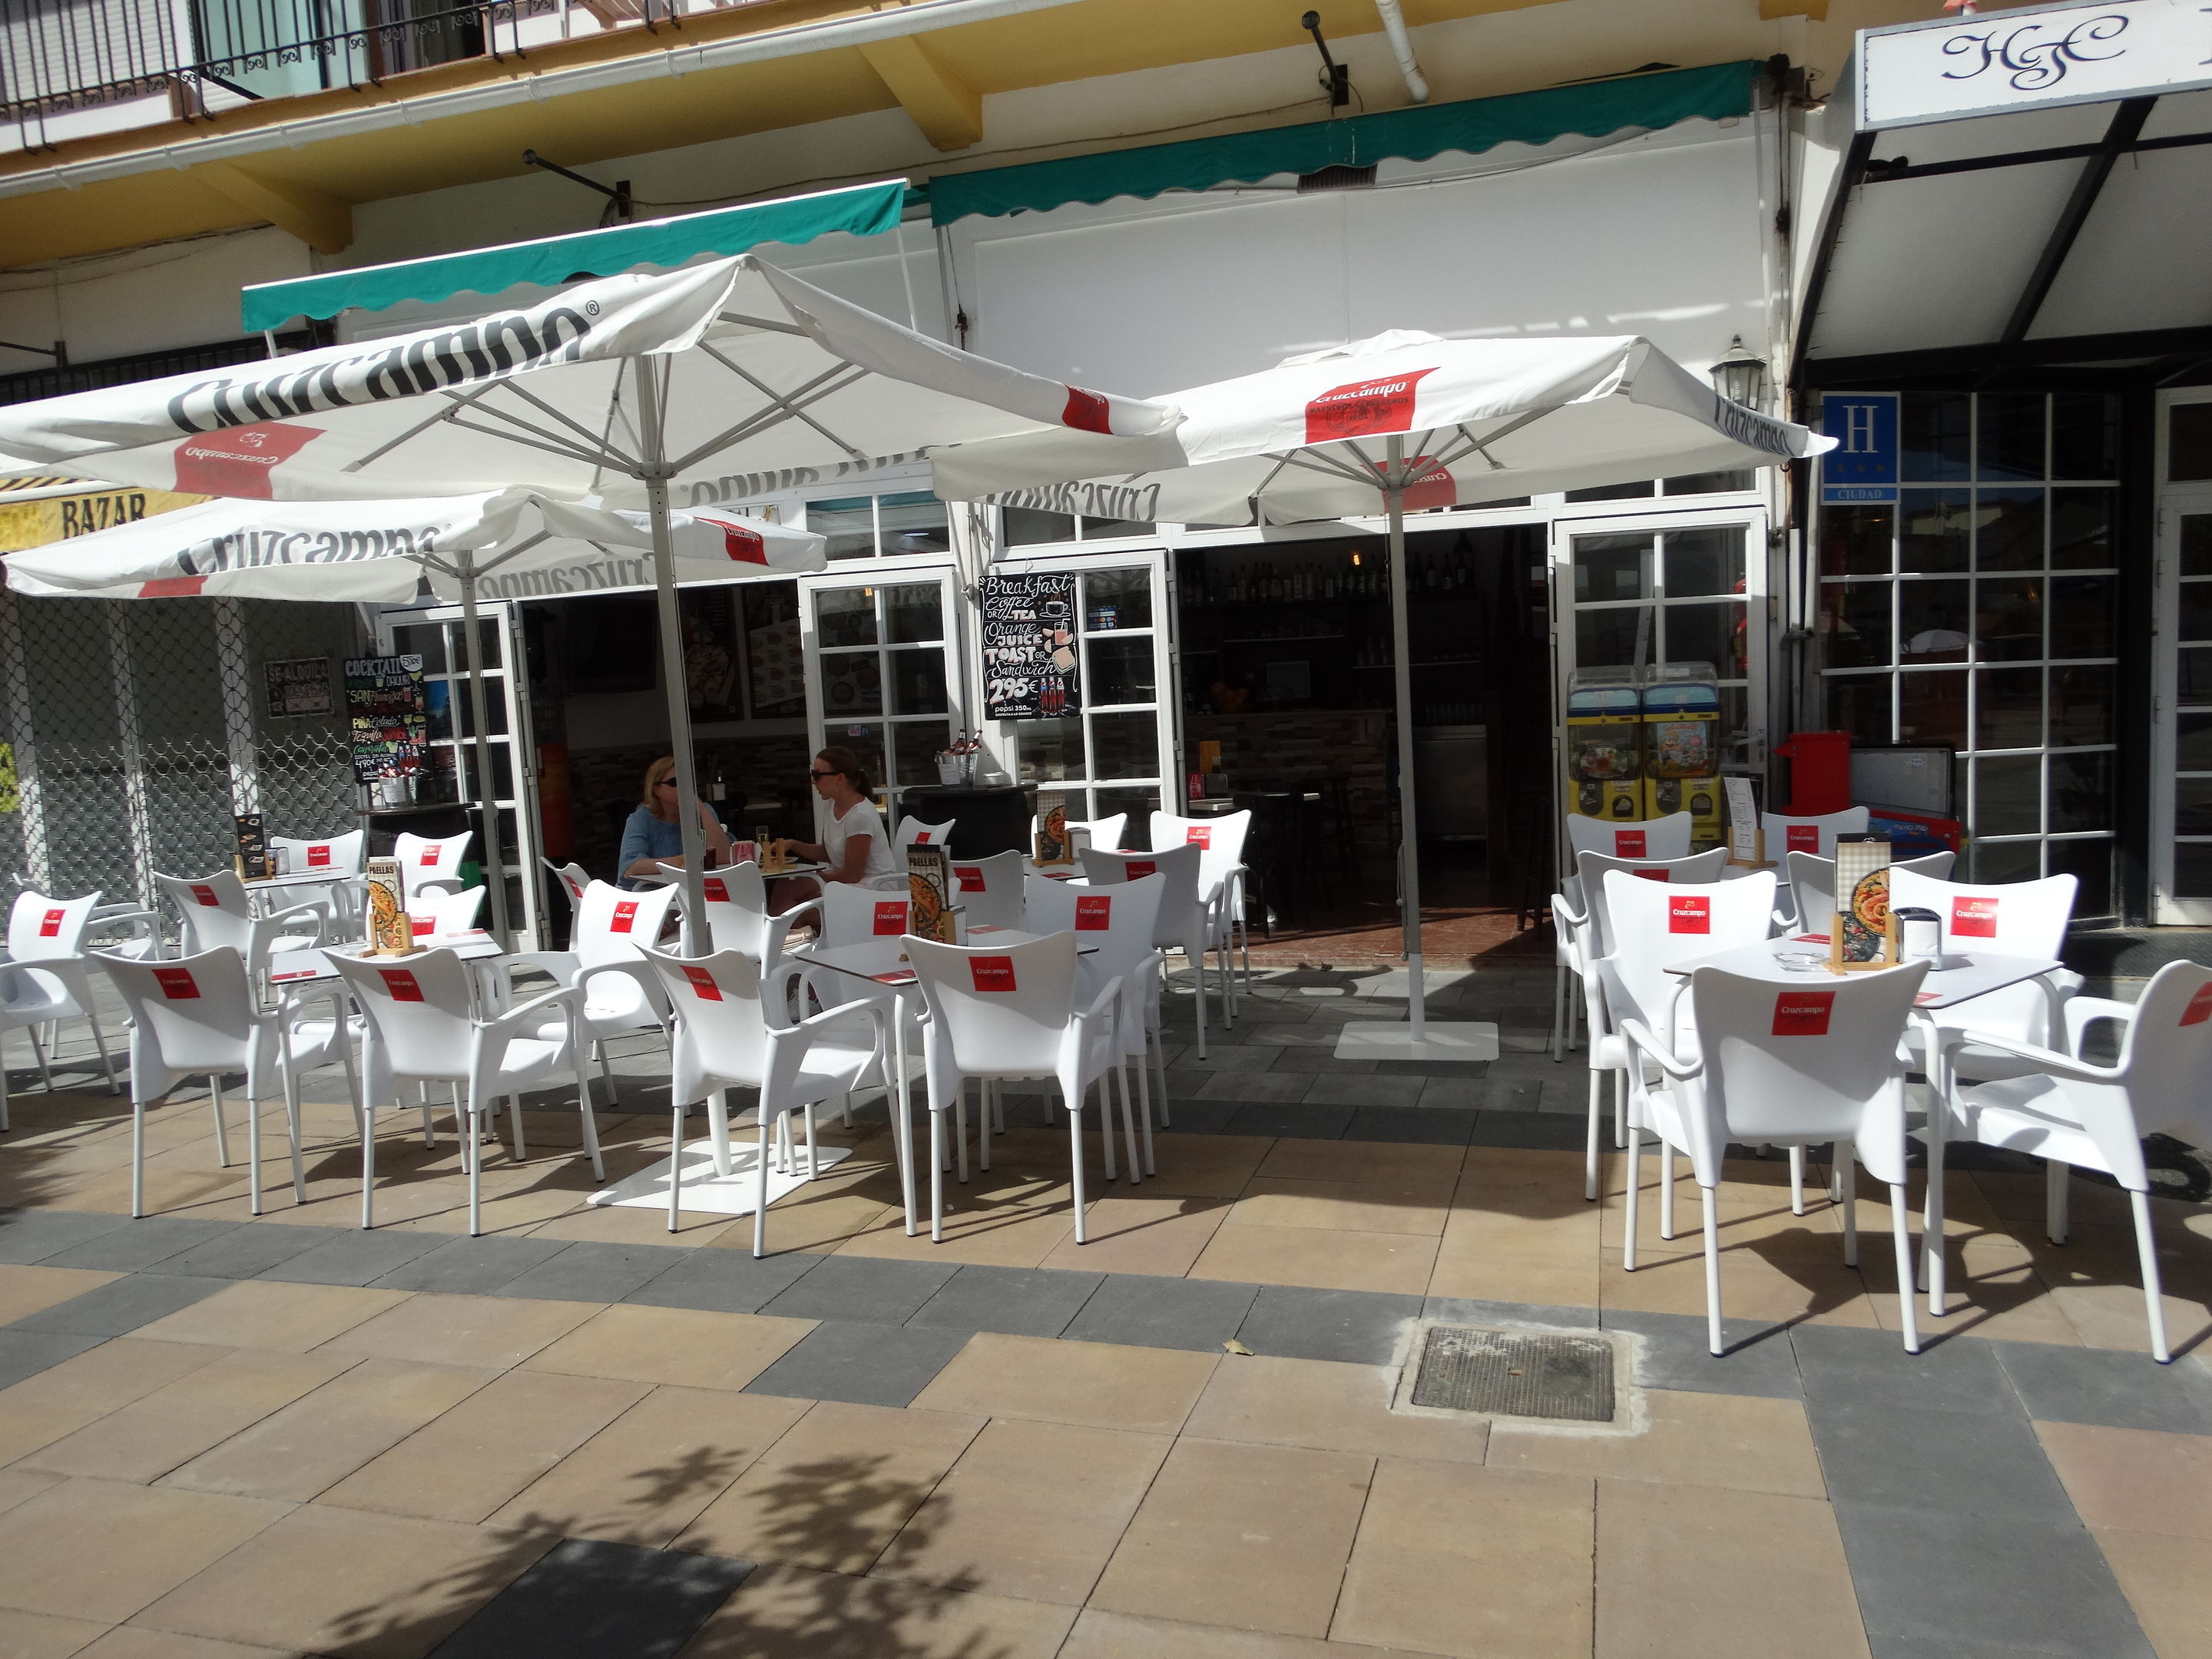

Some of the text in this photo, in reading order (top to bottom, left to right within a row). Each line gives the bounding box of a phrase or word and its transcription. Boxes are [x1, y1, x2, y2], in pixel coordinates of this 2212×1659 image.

[1843, 406, 1879, 453] H
[1838, 489, 1882, 499] CIUDAD
[61, 493, 145, 540] BAZAR
[986, 575, 1071, 598] Breakfast
[985, 596, 1034, 620] Coffee
[1011, 610, 1037, 621] TEA
[985, 622, 1041, 644] Orange
[998, 634, 1042, 646] JUICE
[985, 647, 1036, 664] TOAST
[346, 658, 402, 677] COCKTAIL
[988, 660, 1056, 677] Sandwich
[350, 690, 370, 703] SAN
[369, 866, 394, 874] PAELLAS
[909, 857, 938, 866] PAELLAS
[1956, 909, 1992, 919] Cruzcampo
